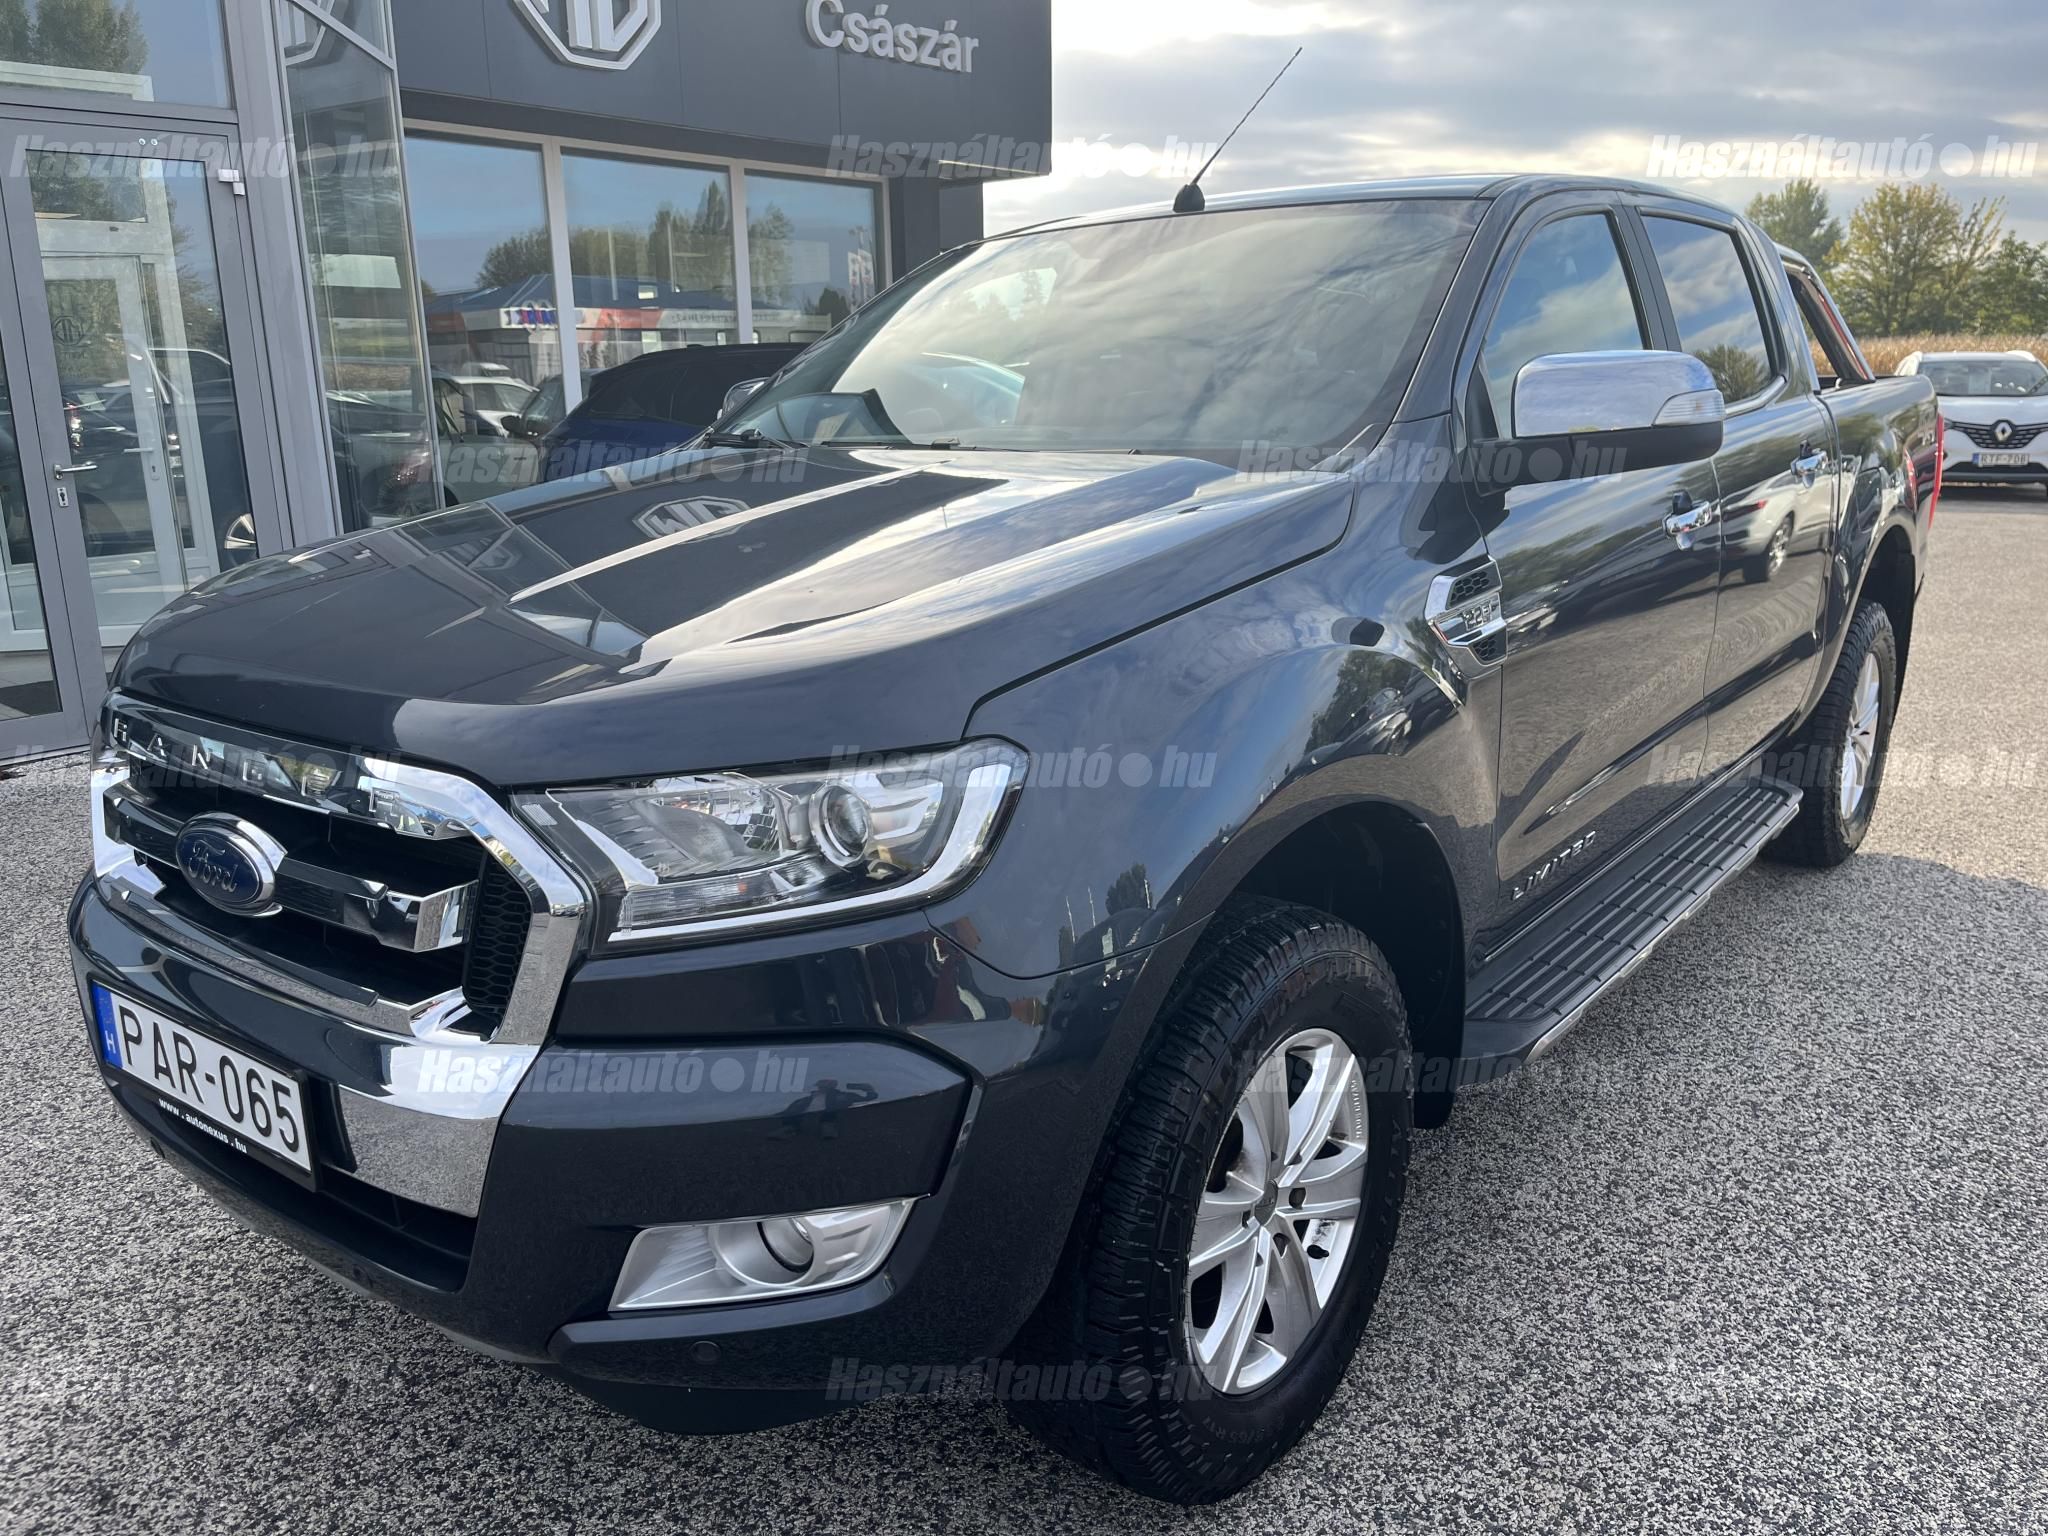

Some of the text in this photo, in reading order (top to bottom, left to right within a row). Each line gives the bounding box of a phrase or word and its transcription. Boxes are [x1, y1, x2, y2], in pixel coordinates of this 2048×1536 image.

[805, 0, 979, 73] Császár
[113, 718, 401, 817] RANGER
[189, 839, 239, 893] Ford
[1511, 830, 1596, 900] LIMITED
[104, 1030, 117, 1055] H
[118, 1004, 300, 1153] PAR-065
